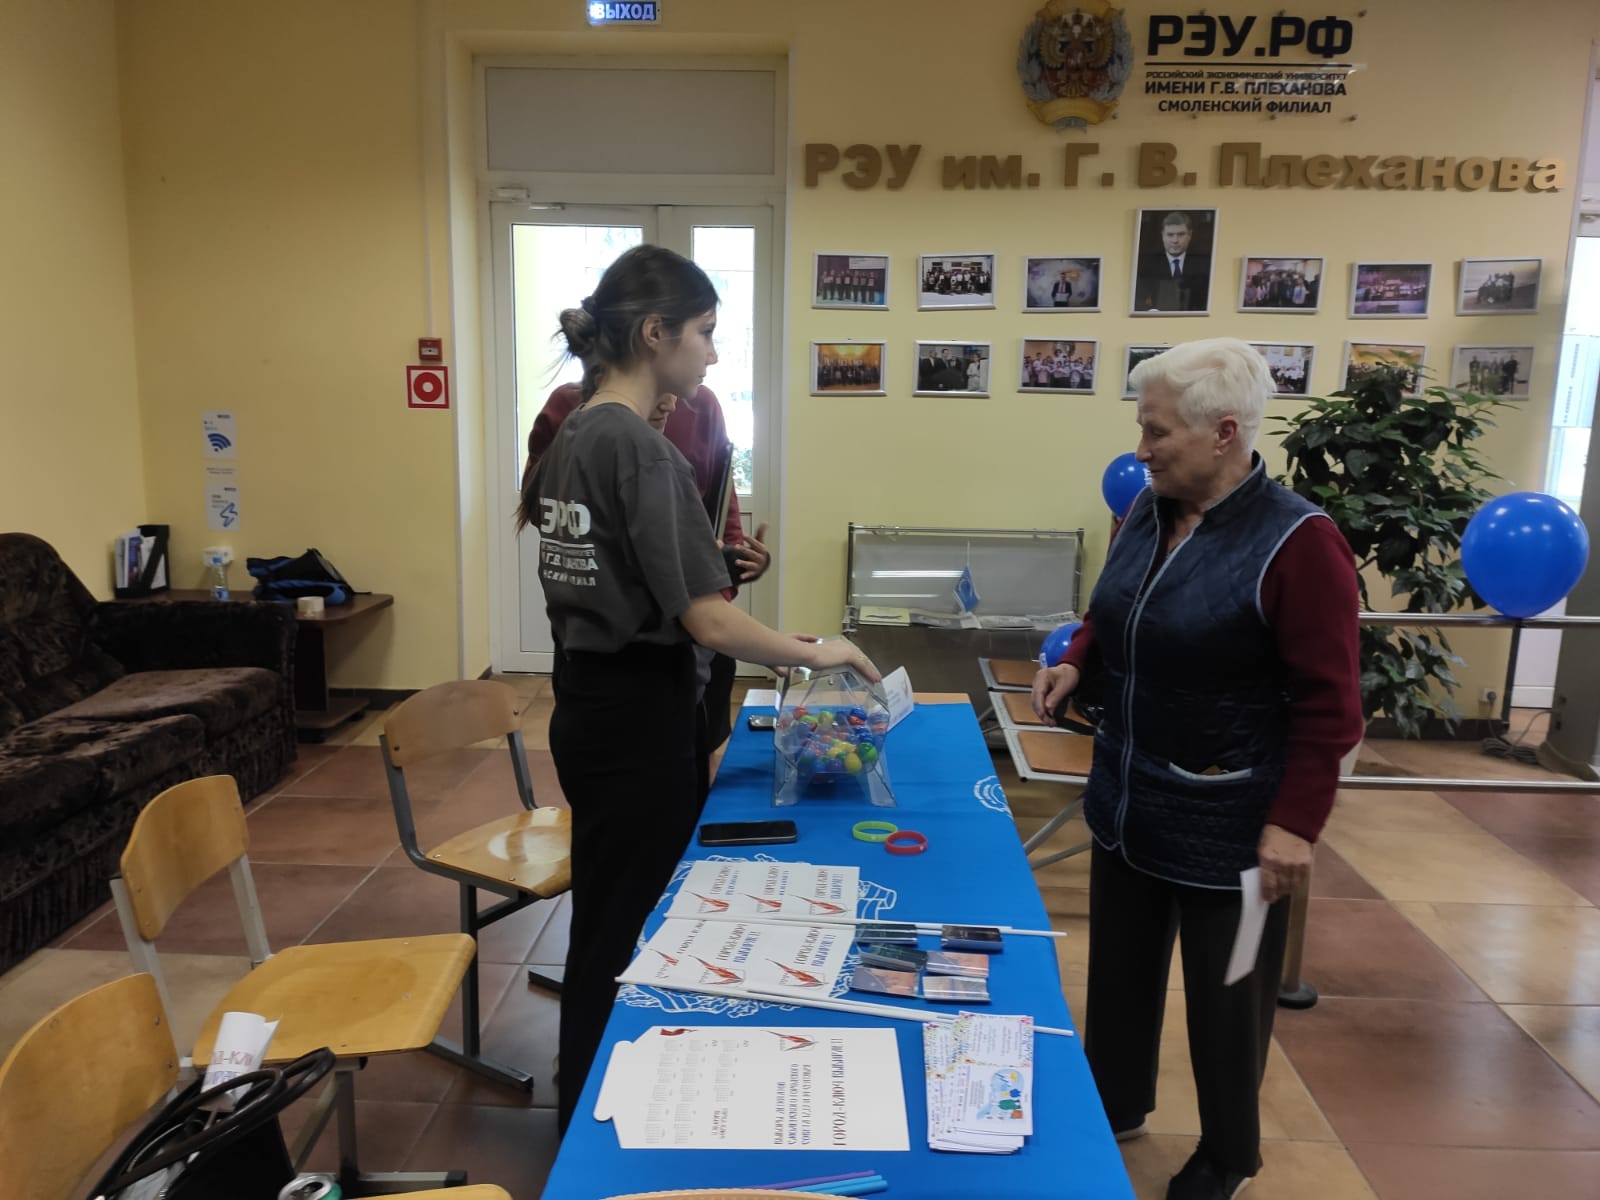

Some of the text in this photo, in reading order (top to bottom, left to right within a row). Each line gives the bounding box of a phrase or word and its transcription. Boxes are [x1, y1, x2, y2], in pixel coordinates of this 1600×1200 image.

[590, 3, 655, 20] ВЫХОД
[1147, 15, 1353, 58] РЭУ.РФ
[1146, 70, 1204, 79] РОССИЙСКИЙ
[1145, 81, 1347, 96] ИМЕНИ Г.В. ПЛЕХАНОВА
[1158, 97, 1332, 113] СМОЛЕНСКИЙ ФИЛИАЛ
[804, 142, 1566, 193] РЭУ им. Г. В. Плеханова
